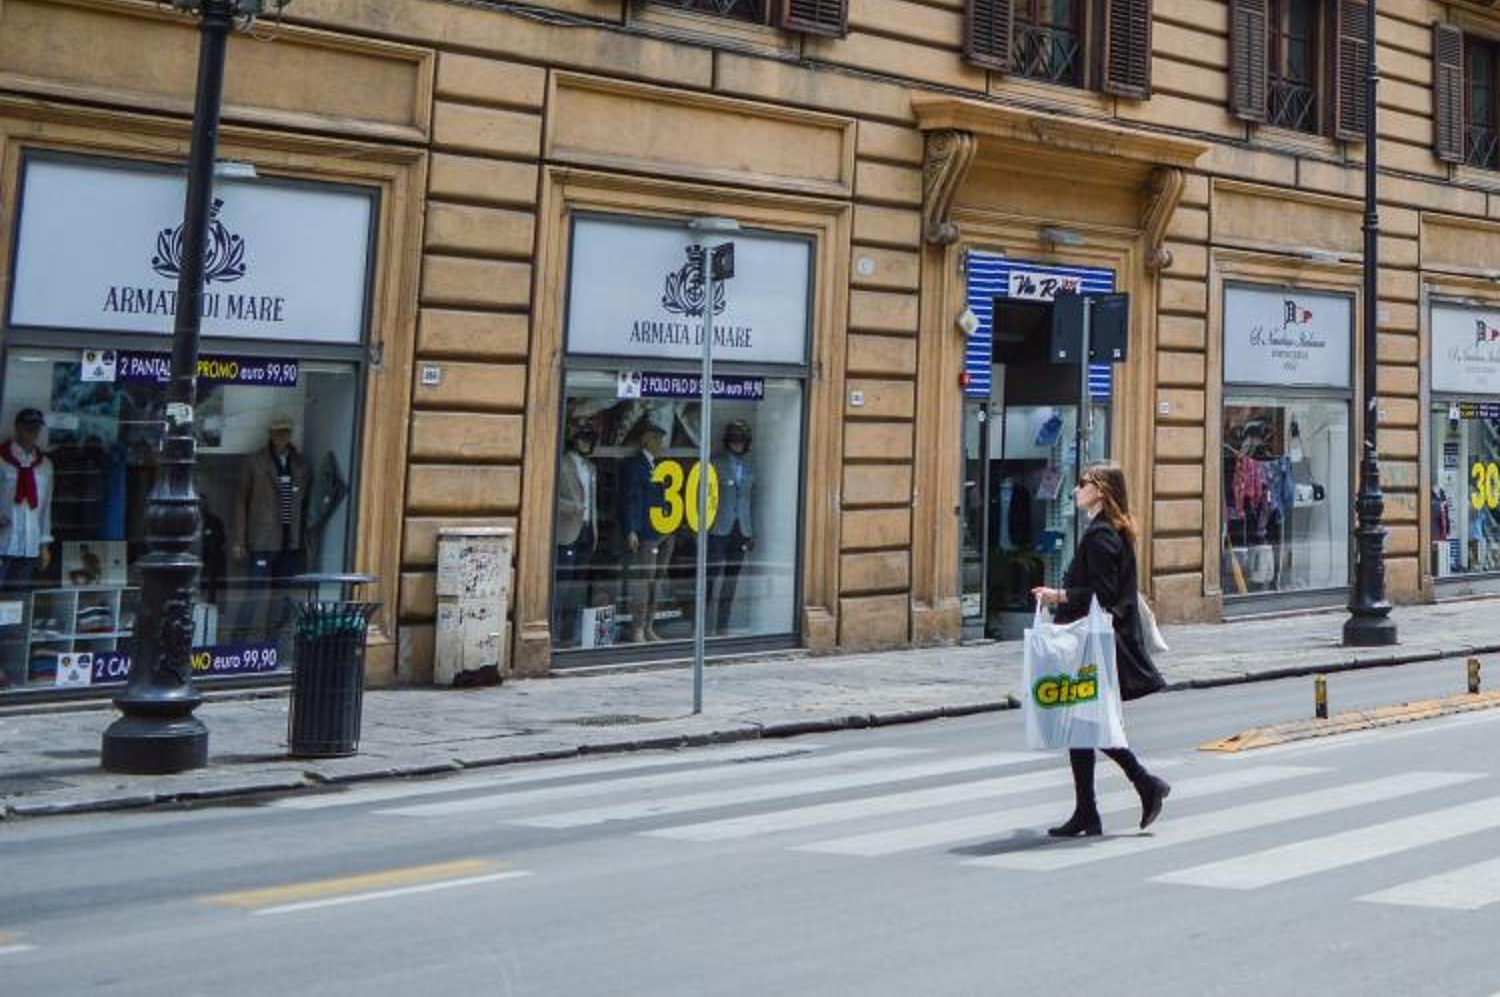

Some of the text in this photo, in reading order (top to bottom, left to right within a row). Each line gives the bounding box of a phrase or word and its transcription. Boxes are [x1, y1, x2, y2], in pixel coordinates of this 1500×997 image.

[103, 287, 285, 322] ARMAT DI MARE
[630, 320, 690, 345] ARMATA
[714, 326, 753, 347] MARE
[120, 357, 128, 375] 2
[197, 361, 238, 379] PROMO
[241, 367, 264, 380] euro
[267, 363, 297, 382] 99,90
[649, 460, 719, 534] 30
[1471, 463, 1500, 509] 30
[95, 660, 104, 678] 2
[213, 656, 241, 669] euro
[243, 648, 277, 670] 99,90
